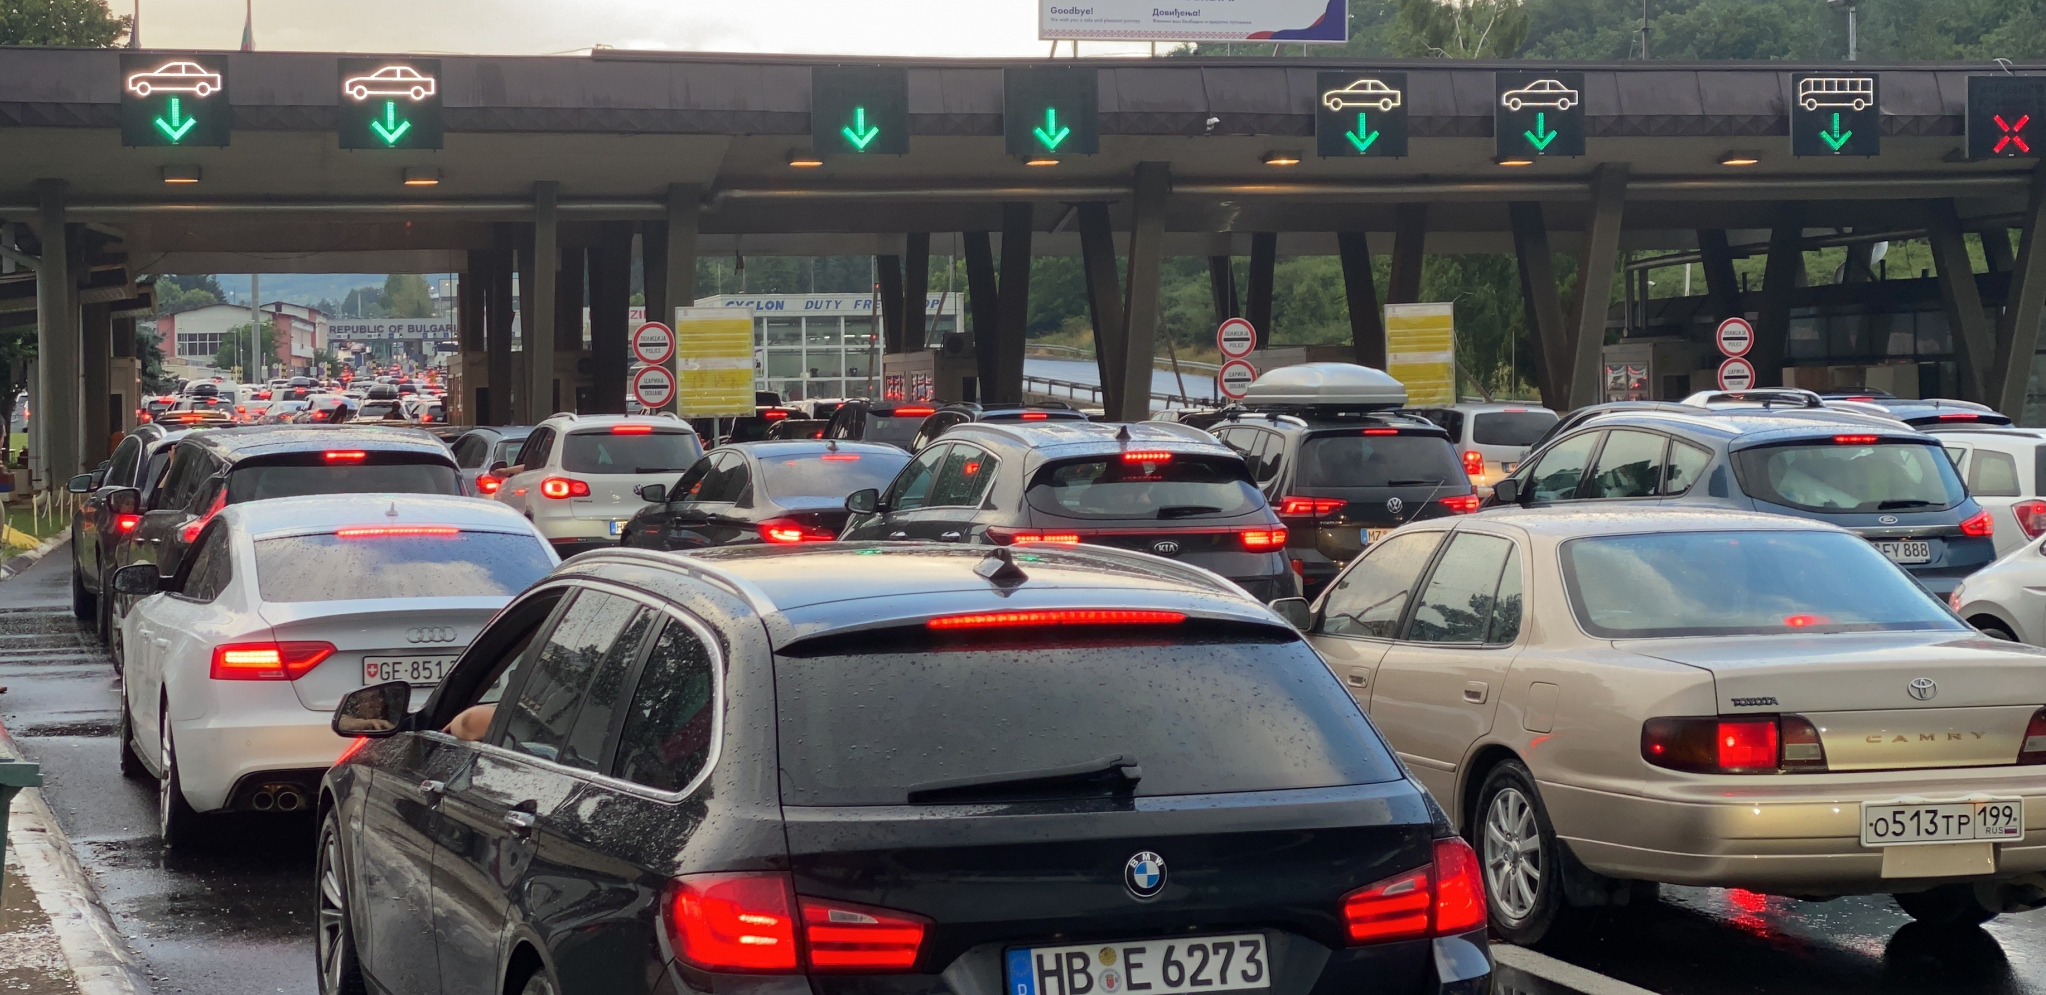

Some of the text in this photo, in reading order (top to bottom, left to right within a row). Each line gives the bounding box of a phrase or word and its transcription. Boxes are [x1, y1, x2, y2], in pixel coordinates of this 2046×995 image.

[1050, 6, 1094, 16] Goodbye!
[1152, 8, 1201, 18] Довиђења!
[804, 300, 841, 310] DUTY
[329, 325, 384, 333] REPUBLIC
[388, 325, 404, 333] OF
[1159, 544, 1175, 552] KIA
[1904, 543, 1928, 557] 888
[1731, 697, 1779, 707] TOYOTA
[1866, 731, 1986, 743] CAMRY
[1978, 805, 2013, 826] 199
[1130, 853, 1164, 868] BMW
[1037, 939, 1263, 995] HB E 6273
[1018, 984, 1027, 995] D
